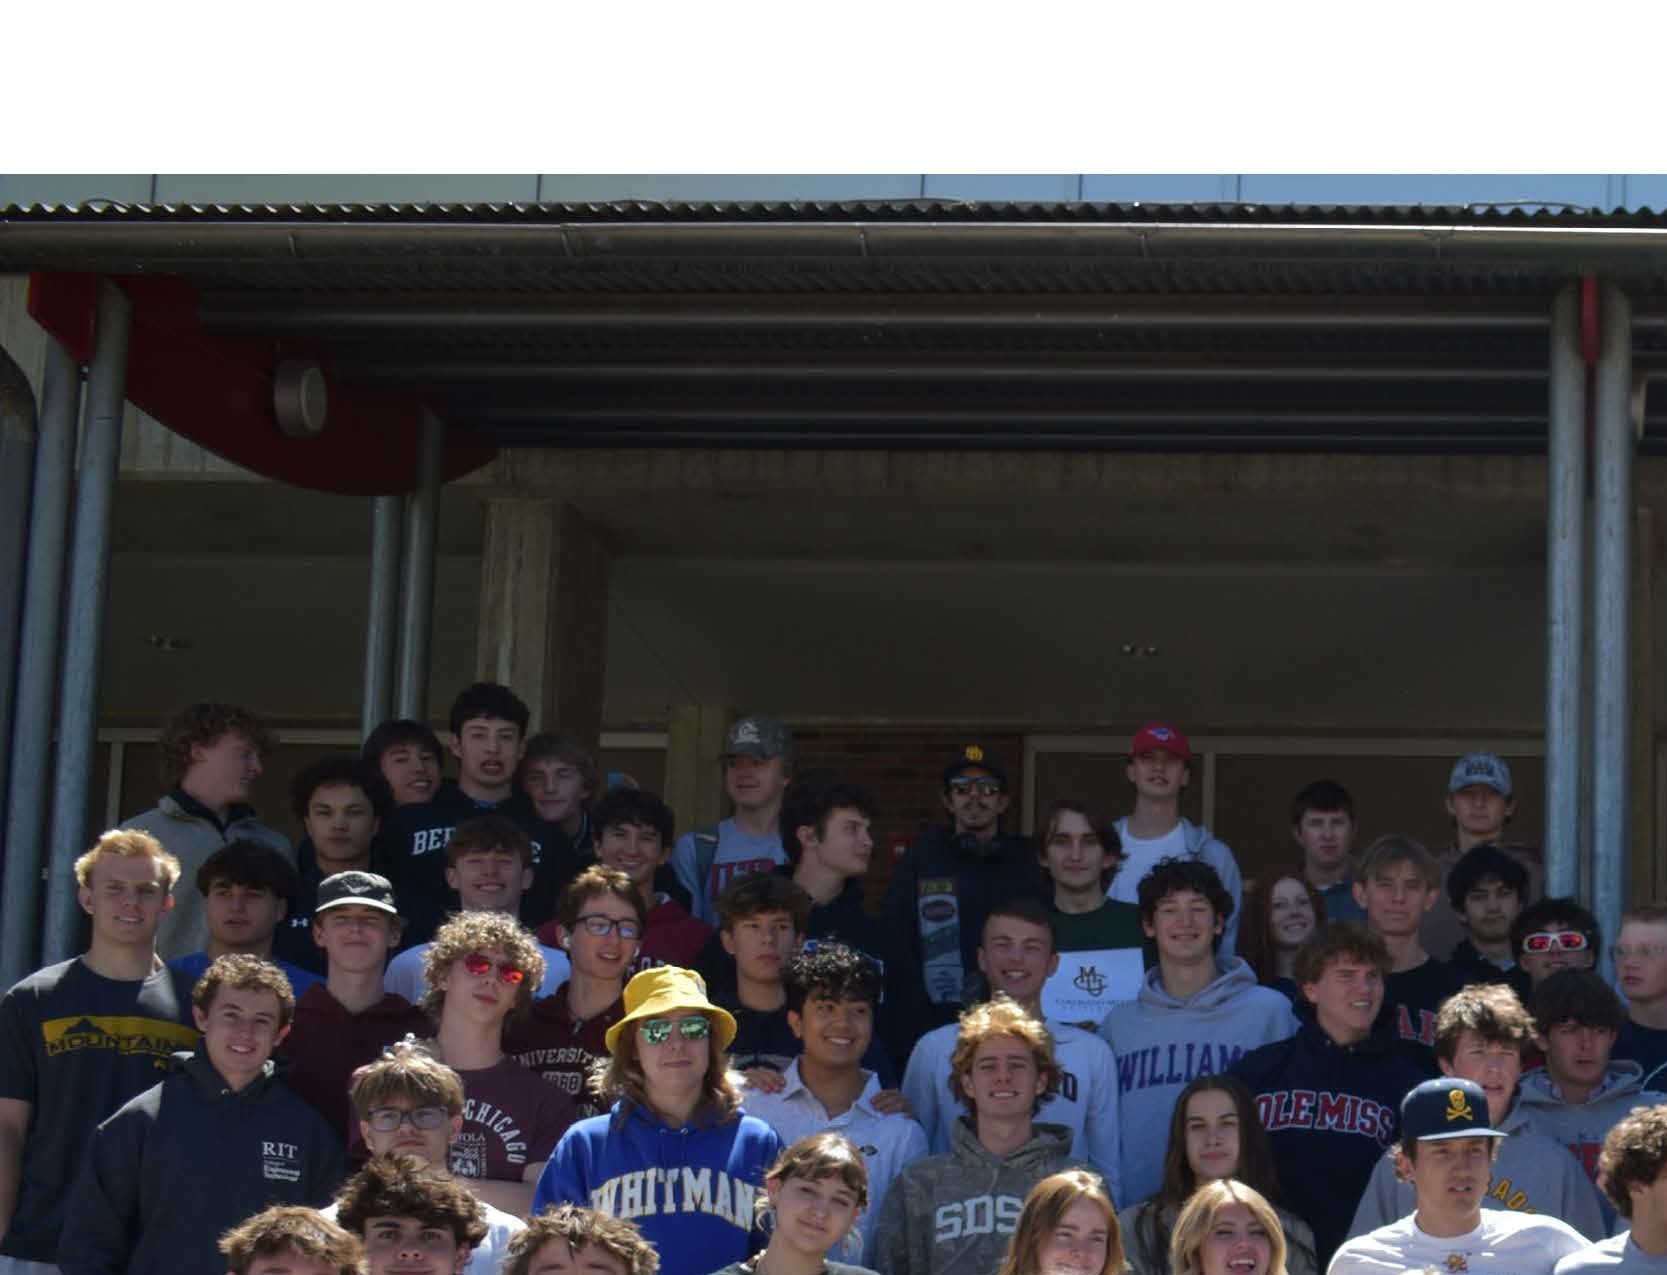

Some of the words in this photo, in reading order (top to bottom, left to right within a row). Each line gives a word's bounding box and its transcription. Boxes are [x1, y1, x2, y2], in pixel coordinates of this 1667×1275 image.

[45, 1031, 178, 1058] MOUNTAIN
[512, 1047, 592, 1067] NIVERSIT
[1116, 1043, 1246, 1096] WILLIAM
[464, 1097, 528, 1164] CHICAGO
[1316, 1091, 1395, 1150] MISS
[262, 1141, 298, 1159] RIT
[593, 1165, 753, 1234] WHITMAN
[935, 1195, 1025, 1243] SDS
